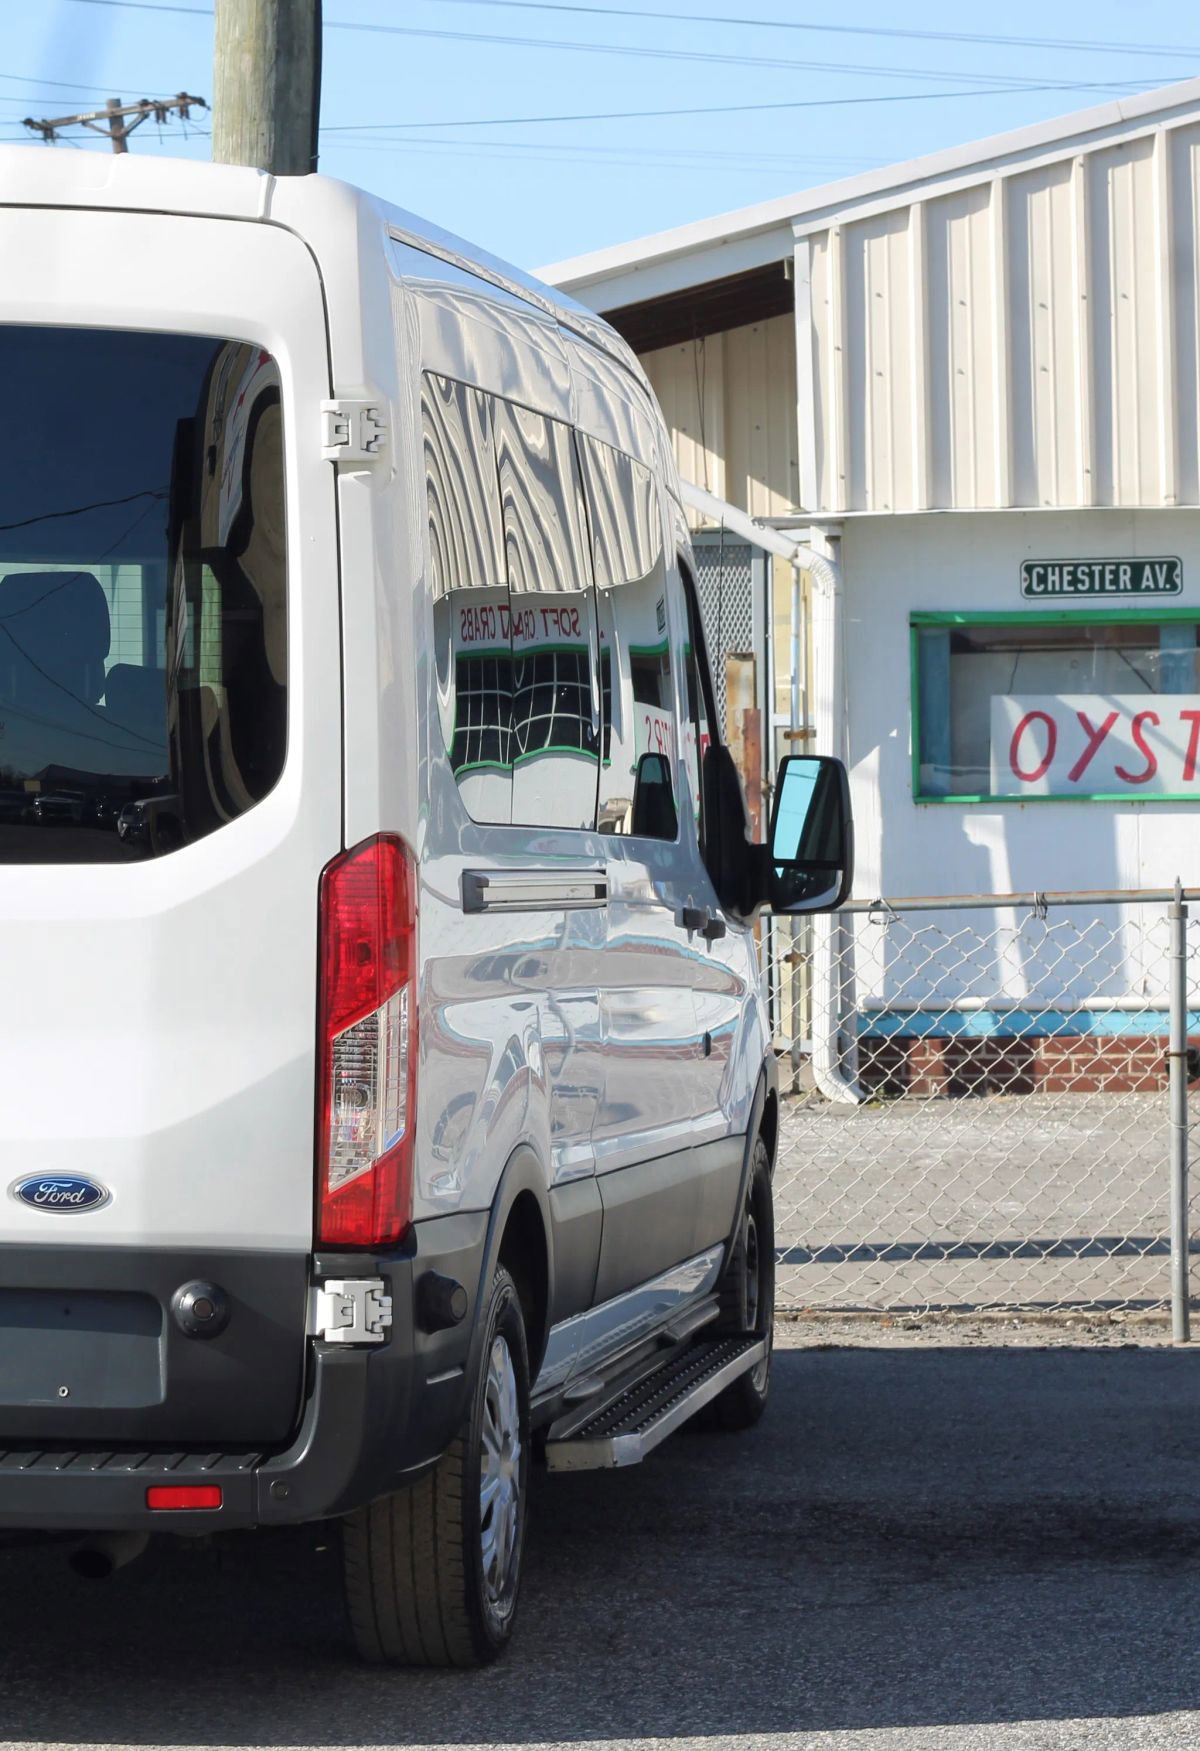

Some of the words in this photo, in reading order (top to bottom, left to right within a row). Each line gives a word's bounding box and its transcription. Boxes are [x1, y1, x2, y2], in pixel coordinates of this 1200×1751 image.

[1031, 565, 1132, 592] CHESTER
[1140, 564, 1171, 590] AV.
[1008, 709, 1200, 785] OYST
[33, 1181, 86, 1203] Ford
